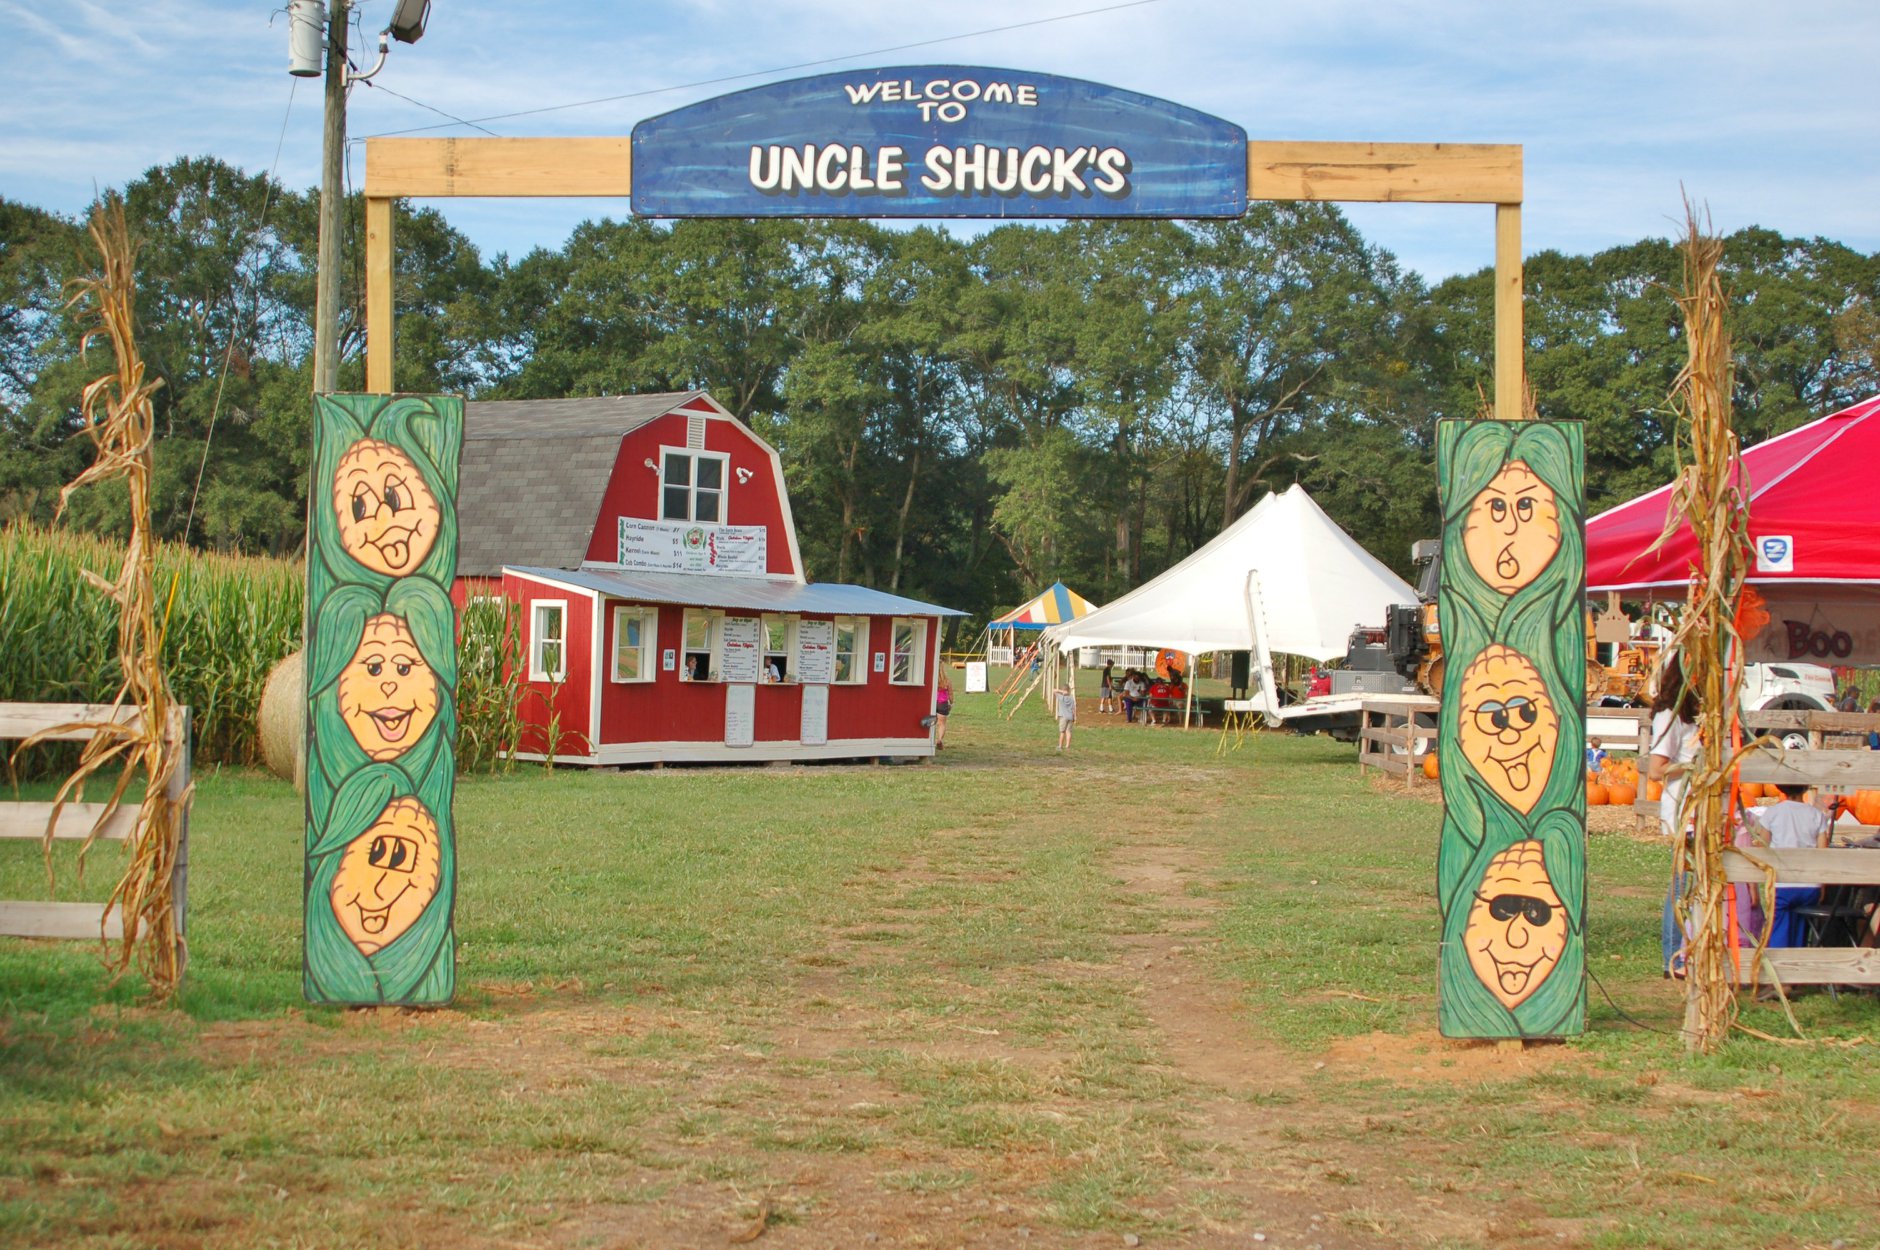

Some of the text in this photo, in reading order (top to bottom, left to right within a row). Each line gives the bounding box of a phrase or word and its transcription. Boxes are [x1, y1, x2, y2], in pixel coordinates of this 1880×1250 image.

[845, 79, 1039, 106] WELCOME
[917, 101, 968, 123] TO
[749, 143, 904, 192] UNCLE
[920, 143, 1128, 193] SHUCK'S
[1782, 620, 1853, 660] Boo
